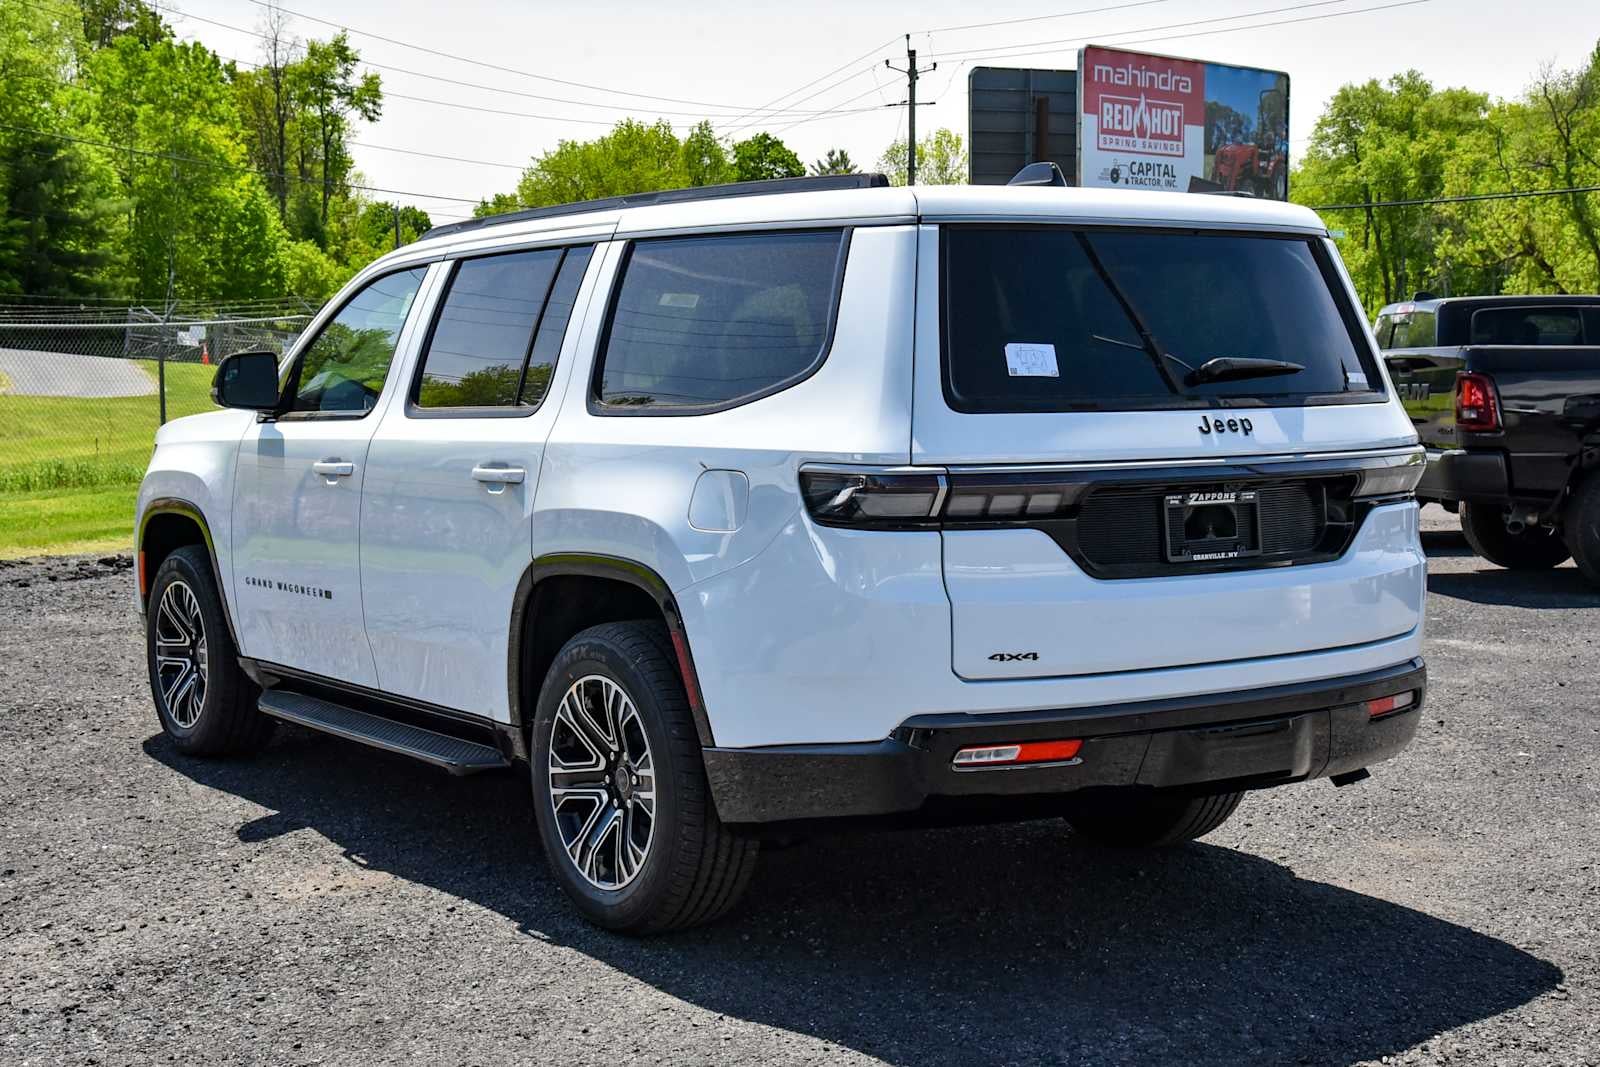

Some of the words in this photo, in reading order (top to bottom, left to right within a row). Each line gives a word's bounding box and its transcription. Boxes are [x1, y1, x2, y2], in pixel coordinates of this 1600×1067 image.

[1094, 64, 1192, 93] mahindra
[1103, 102, 1133, 131] RED
[1151, 109, 1181, 136] HOT
[1103, 137, 1137, 150] SPRING
[1142, 141, 1181, 152] SAVINGS
[1130, 161, 1177, 178] CAPITAL
[1398, 383, 1430, 400] AM
[1198, 415, 1253, 436] Jeep
[1188, 492, 1236, 505] ZAPPONE
[245, 577, 272, 588] GRAND
[277, 582, 323, 597] WAGONEER
[987, 652, 1040, 662] 4x4
